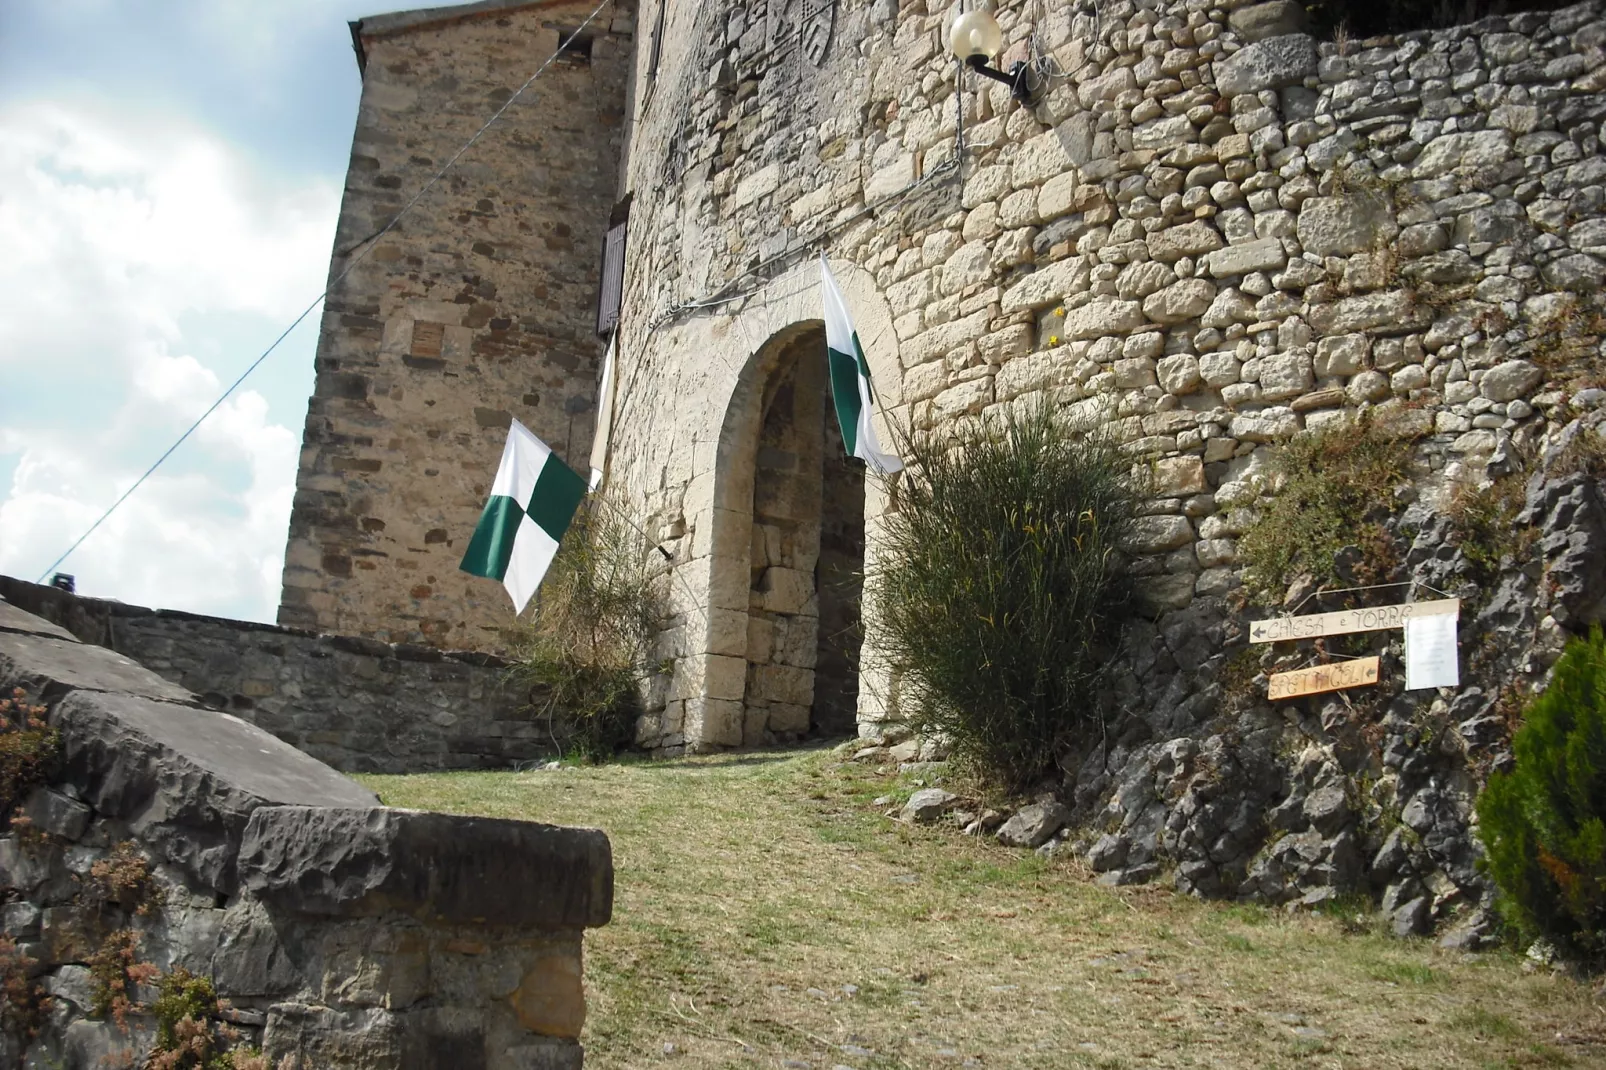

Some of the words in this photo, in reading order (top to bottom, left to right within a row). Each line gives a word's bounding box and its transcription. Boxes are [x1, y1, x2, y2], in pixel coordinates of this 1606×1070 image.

[1267, 617, 1324, 639] CHIESA
[1352, 605, 1413, 628] TORRE
[1269, 665, 1365, 697] SPETTACOLI
